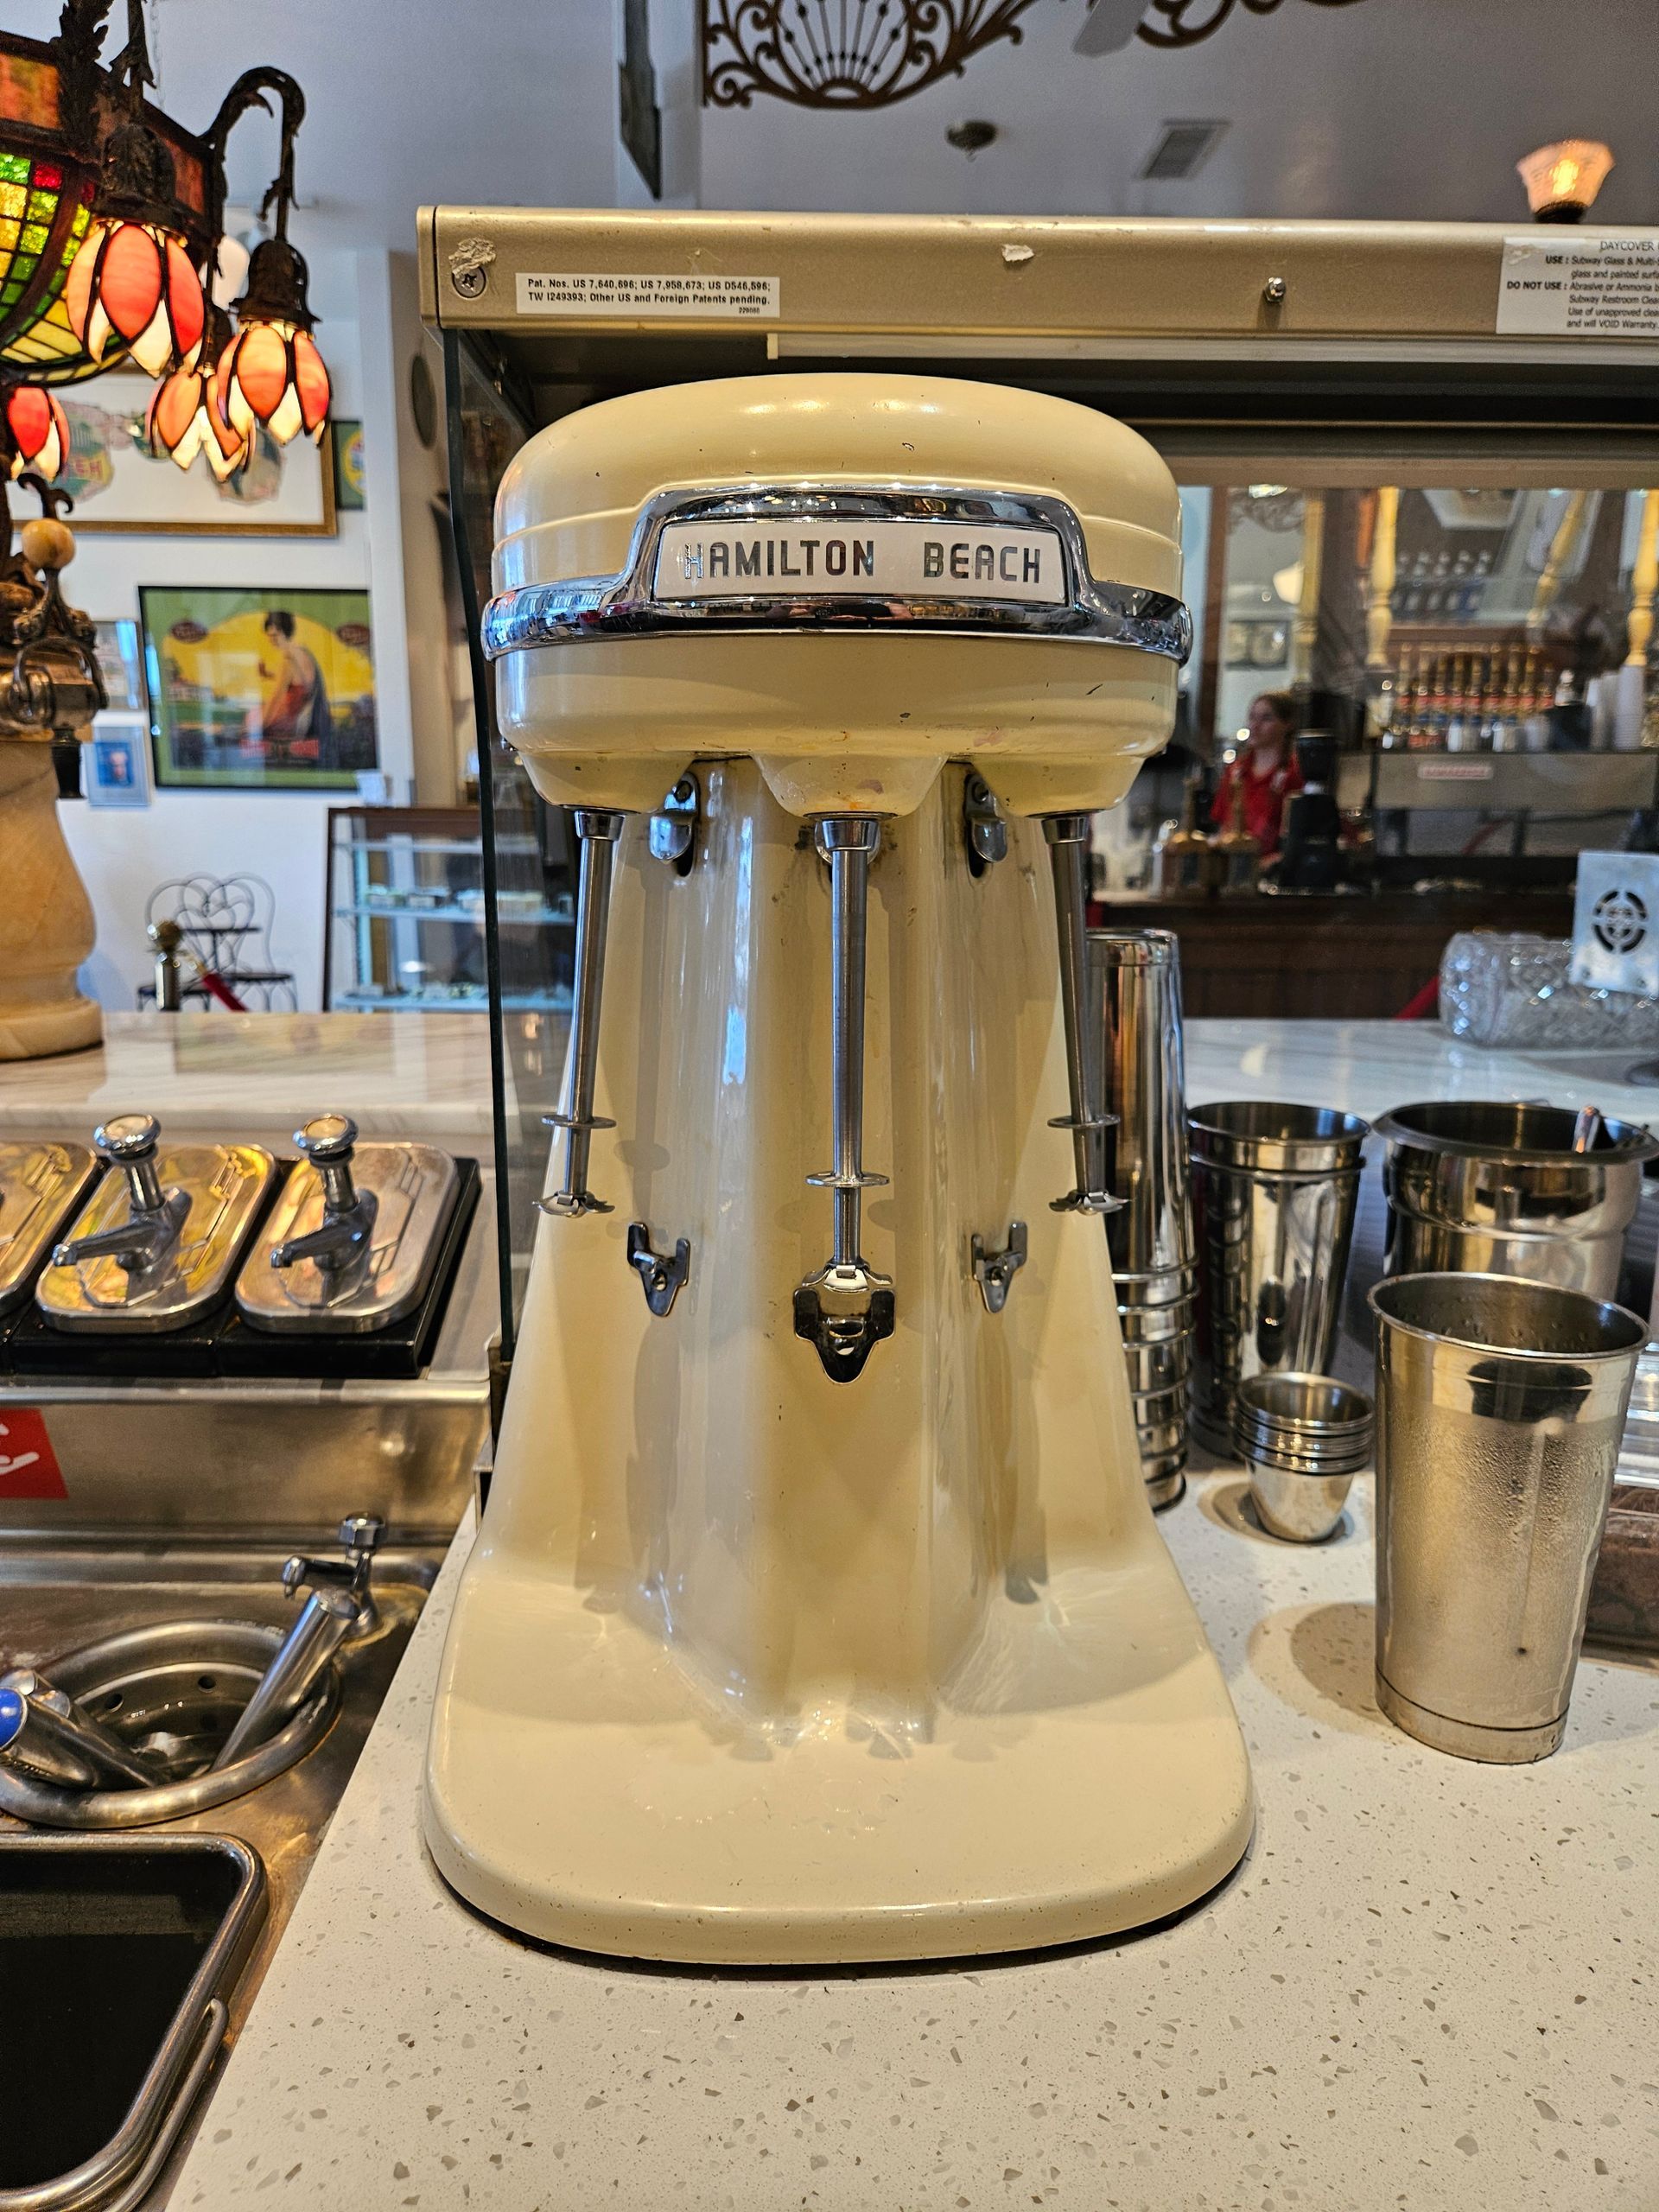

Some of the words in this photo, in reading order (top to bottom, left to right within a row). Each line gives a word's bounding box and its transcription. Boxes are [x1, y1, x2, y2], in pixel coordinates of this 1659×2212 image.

[1600, 240, 1655, 251] DAYCOVER
[1604, 256, 1625, 265] Glass
[1627, 257, 1633, 265] &
[1571, 270, 1592, 280] glass
[1593, 270, 1608, 278] and
[1610, 270, 1639, 280] painted
[528, 278, 545, 288] Pat.
[549, 279, 569, 289] Nos.
[573, 279, 586, 289] US
[589, 279, 638, 290] 7,640,696;
[641, 280, 653, 289] US
[709, 281, 721, 290] US
[1507, 281, 1521, 289] DO
[1522, 281, 1542, 289] NOT
[1570, 282, 1604, 291] Abrasive
[529, 292, 543, 301] TW
[589, 293, 614, 302] Other
[619, 293, 631, 302] US
[634, 294, 651, 302] and
[654, 294, 690, 305] Foreign
[693, 294, 726, 304] Patents
[729, 295, 771, 305] pending.
[1569, 295, 1599, 305] Subway
[1602, 295, 1639, 304] Restroom
[1567, 307, 1583, 316] Use
[1585, 308, 1593, 316] of
[1595, 308, 1641, 318] unapproved
[1567, 318, 1581, 327] and
[1584, 319, 1596, 327] will
[1599, 319, 1619, 328] VOID
[684, 540, 874, 580] HAMILTON
[923, 542, 1041, 584] BEACH
